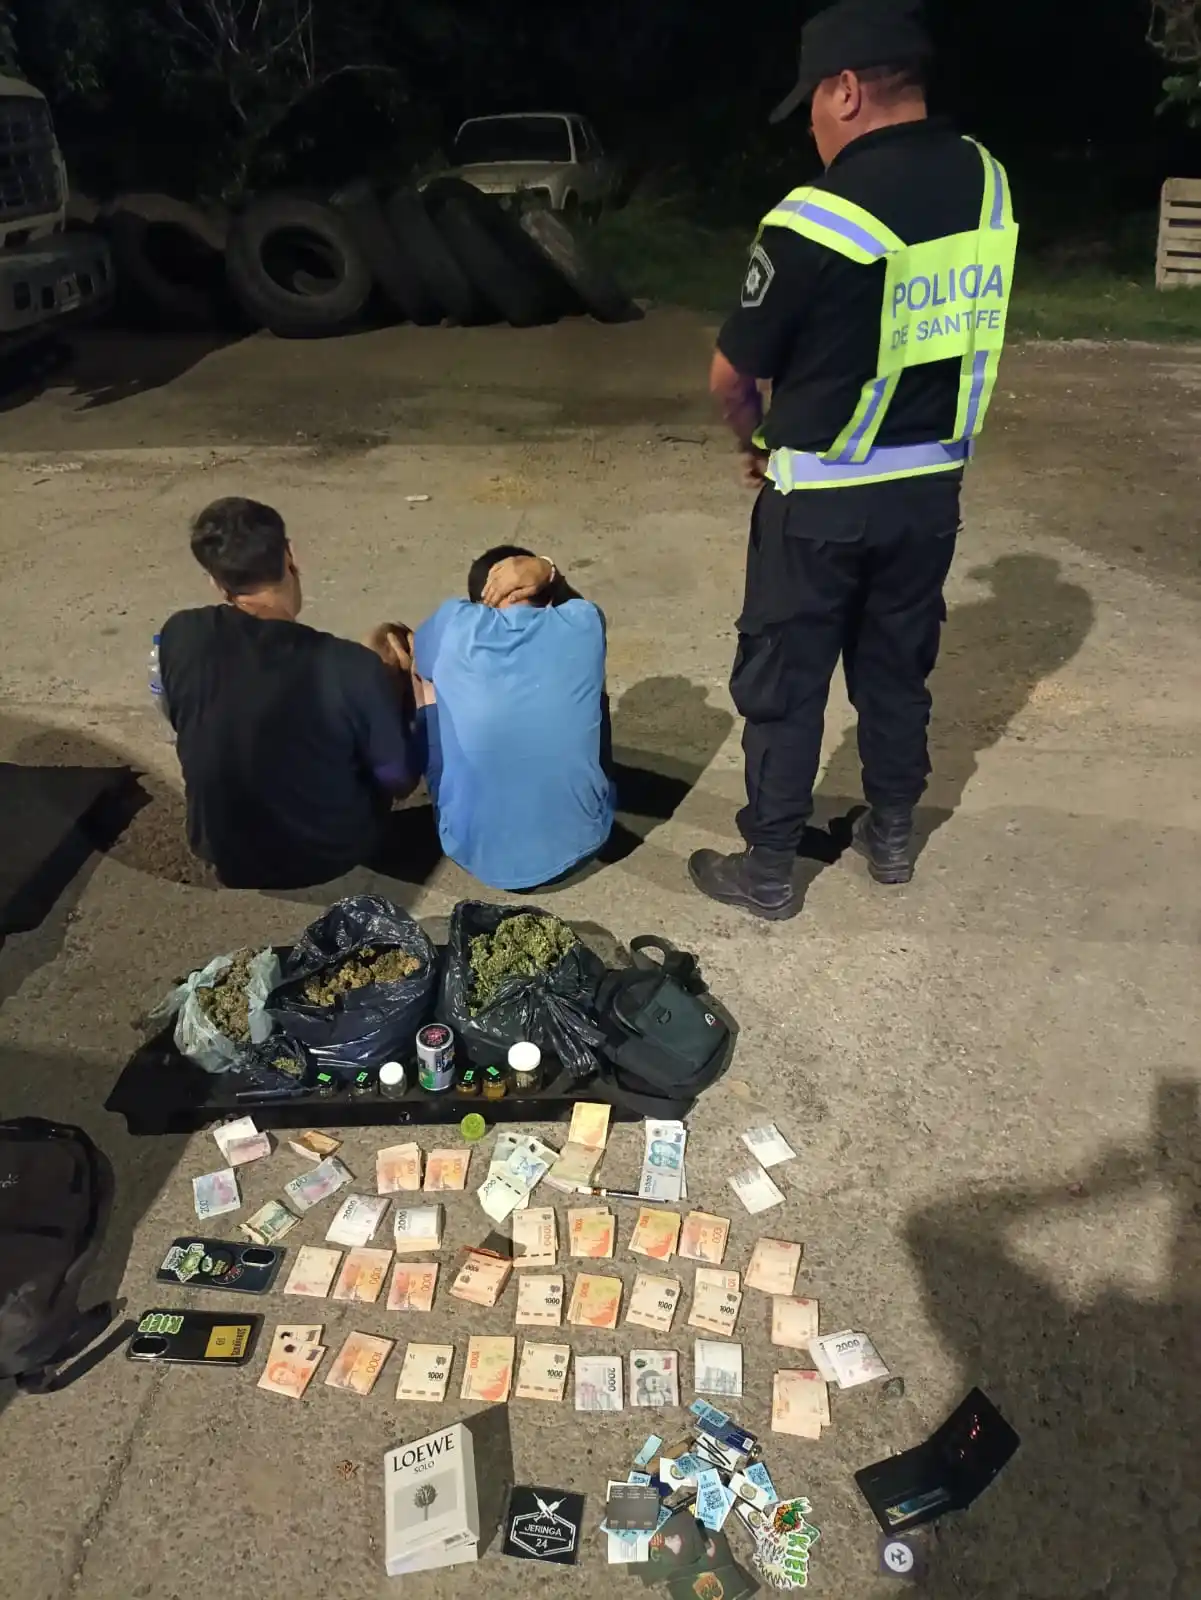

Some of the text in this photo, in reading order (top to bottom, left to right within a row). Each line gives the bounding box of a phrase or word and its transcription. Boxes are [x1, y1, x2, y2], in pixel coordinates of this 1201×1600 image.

[890, 324, 909, 350] DE
[976, 310, 1001, 329] FE
[397, 1210, 408, 1231] 2000
[544, 1297, 561, 1305] 1000
[658, 1300, 673, 1310] 1000
[720, 1305, 735, 1315] 1000
[836, 1339, 860, 1352] 2000
[428, 1371, 444, 1380] 1000
[547, 1369, 563, 1378] 1000
[607, 1367, 617, 1392] 2000
[393, 1433, 455, 1472] LOEWE
[413, 1460, 435, 1474] SOLO
[524, 1523, 562, 1537] JERINGA
[535, 1538, 548, 1549] 24
[784, 1533, 811, 1587] KIEF
